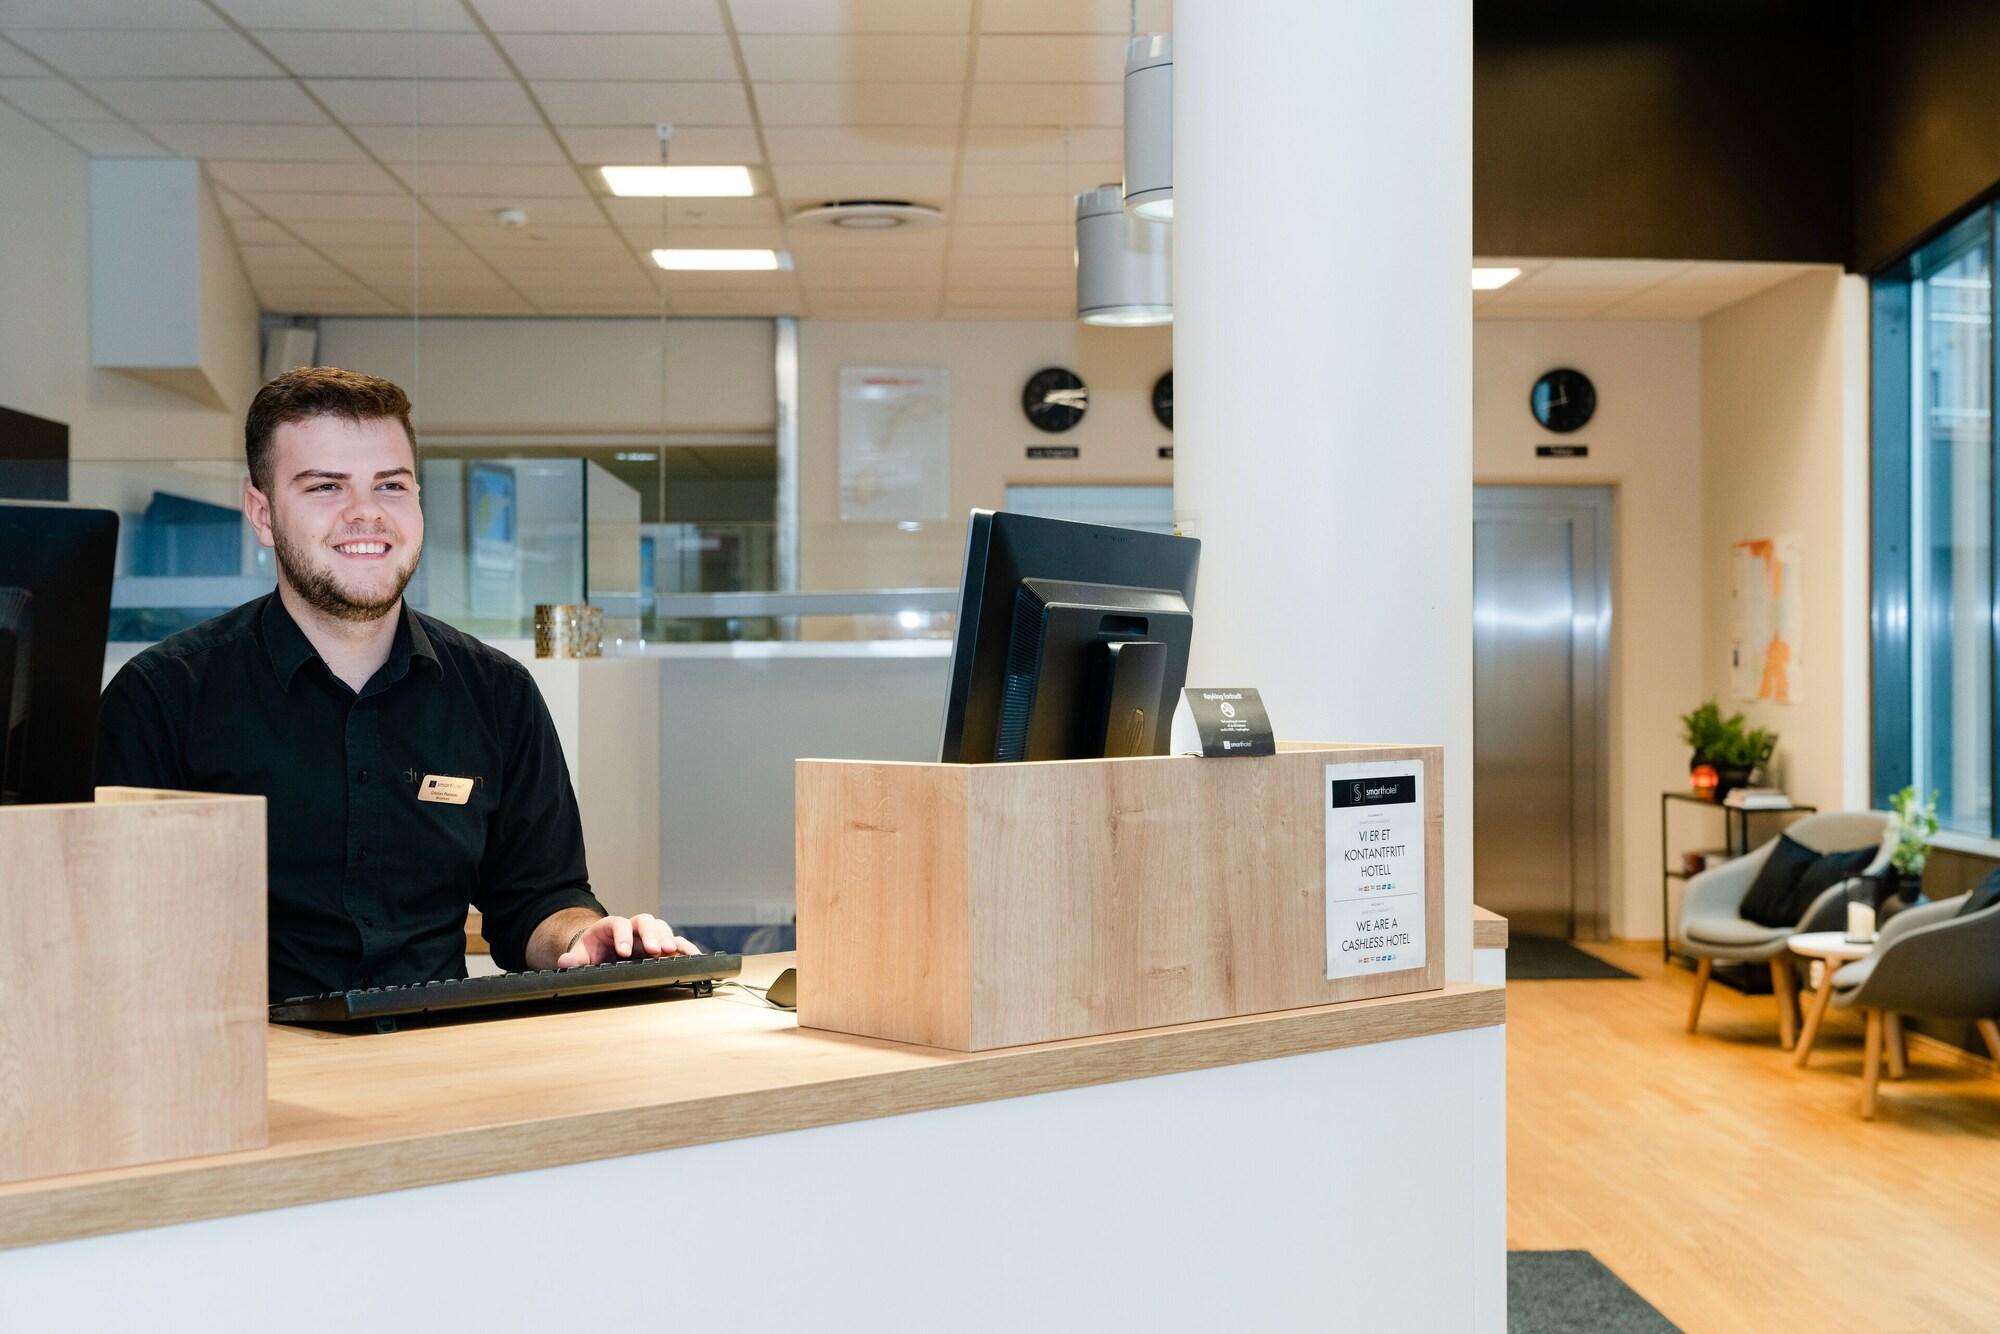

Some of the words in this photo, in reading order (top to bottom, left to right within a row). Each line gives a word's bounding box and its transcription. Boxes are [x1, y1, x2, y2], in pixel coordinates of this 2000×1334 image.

[1366, 784, 1397, 796] smarthotel
[1359, 831, 1367, 842] VI
[1370, 830, 1379, 841] ER
[1382, 829, 1390, 840] ET
[1344, 845, 1405, 861] KONTANTFRITT
[1360, 864, 1391, 877] HOTELL
[1356, 920, 1371, 932] WE
[1374, 918, 1389, 931] ARE
[1392, 918, 1398, 929] A
[1342, 936, 1384, 952] CASHLESS
[1386, 933, 1411, 947] HOTEL
